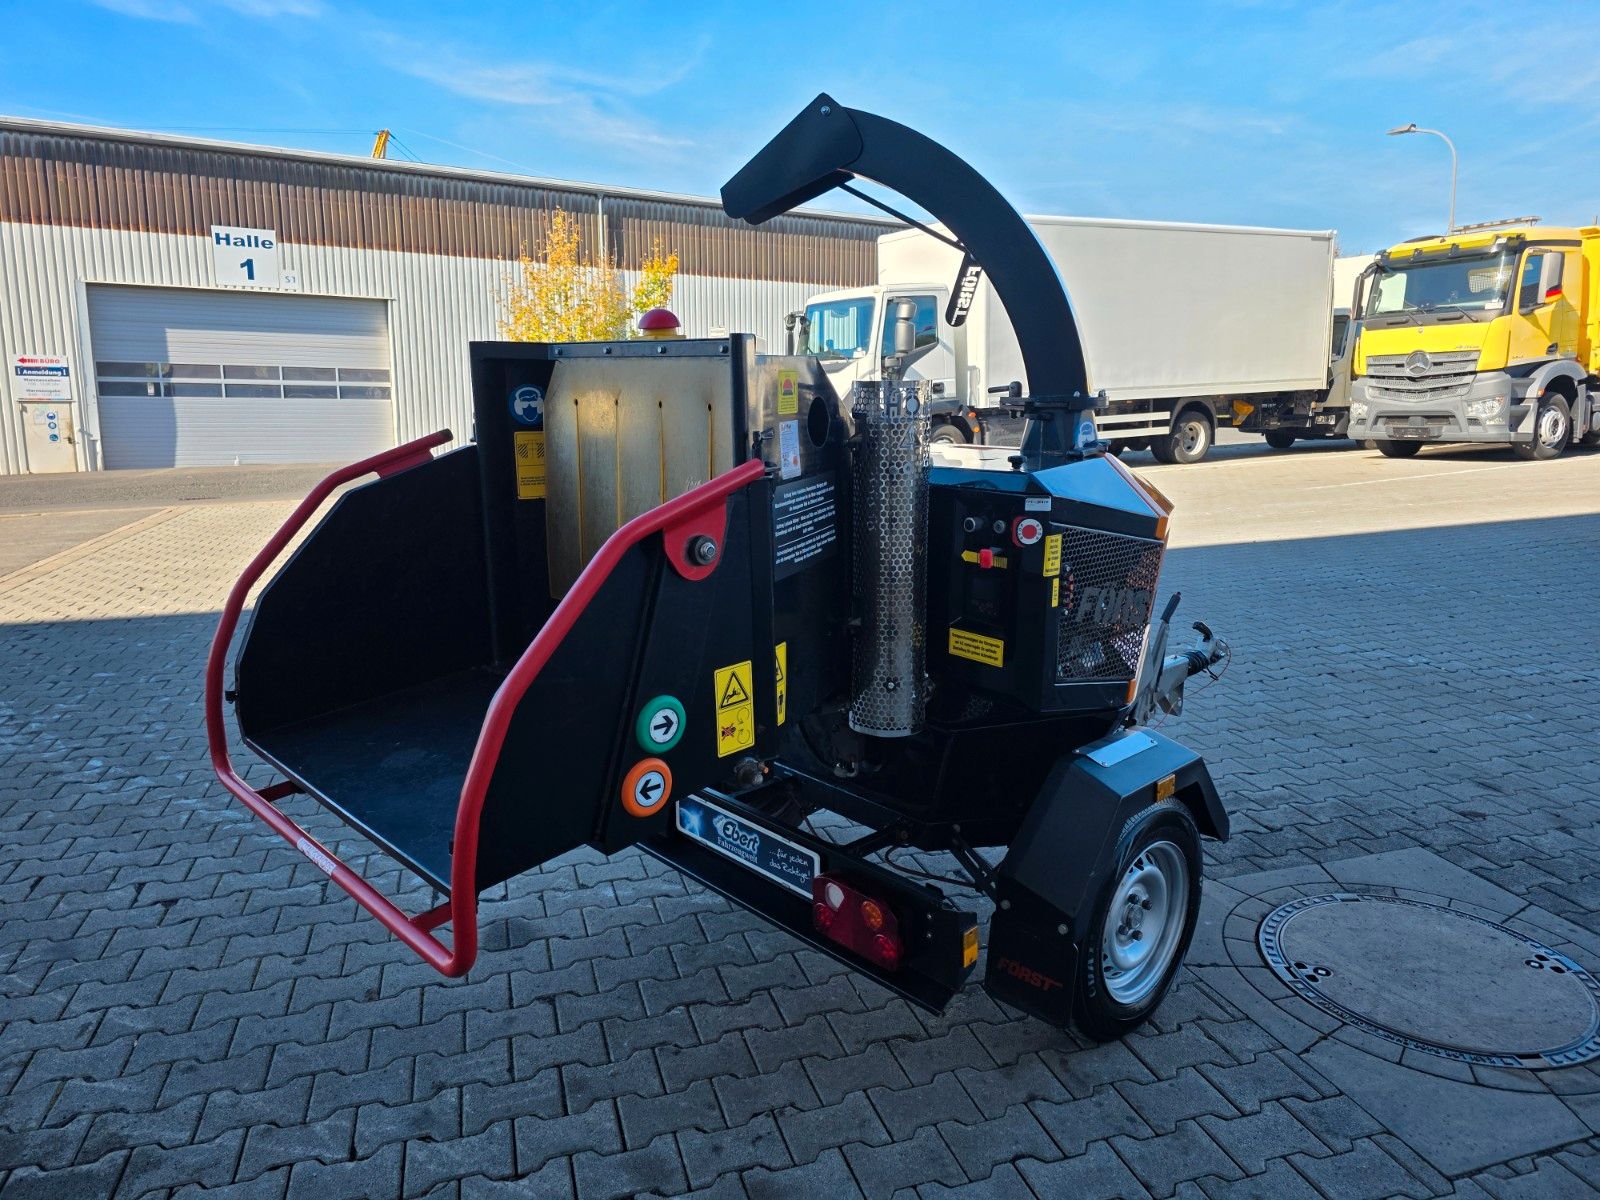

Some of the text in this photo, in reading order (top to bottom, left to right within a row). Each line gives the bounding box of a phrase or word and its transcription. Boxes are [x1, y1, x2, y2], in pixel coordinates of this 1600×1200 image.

[215, 232, 274, 249] Halle
[240, 258, 255, 280] 1
[723, 820, 758, 853] Ebert
